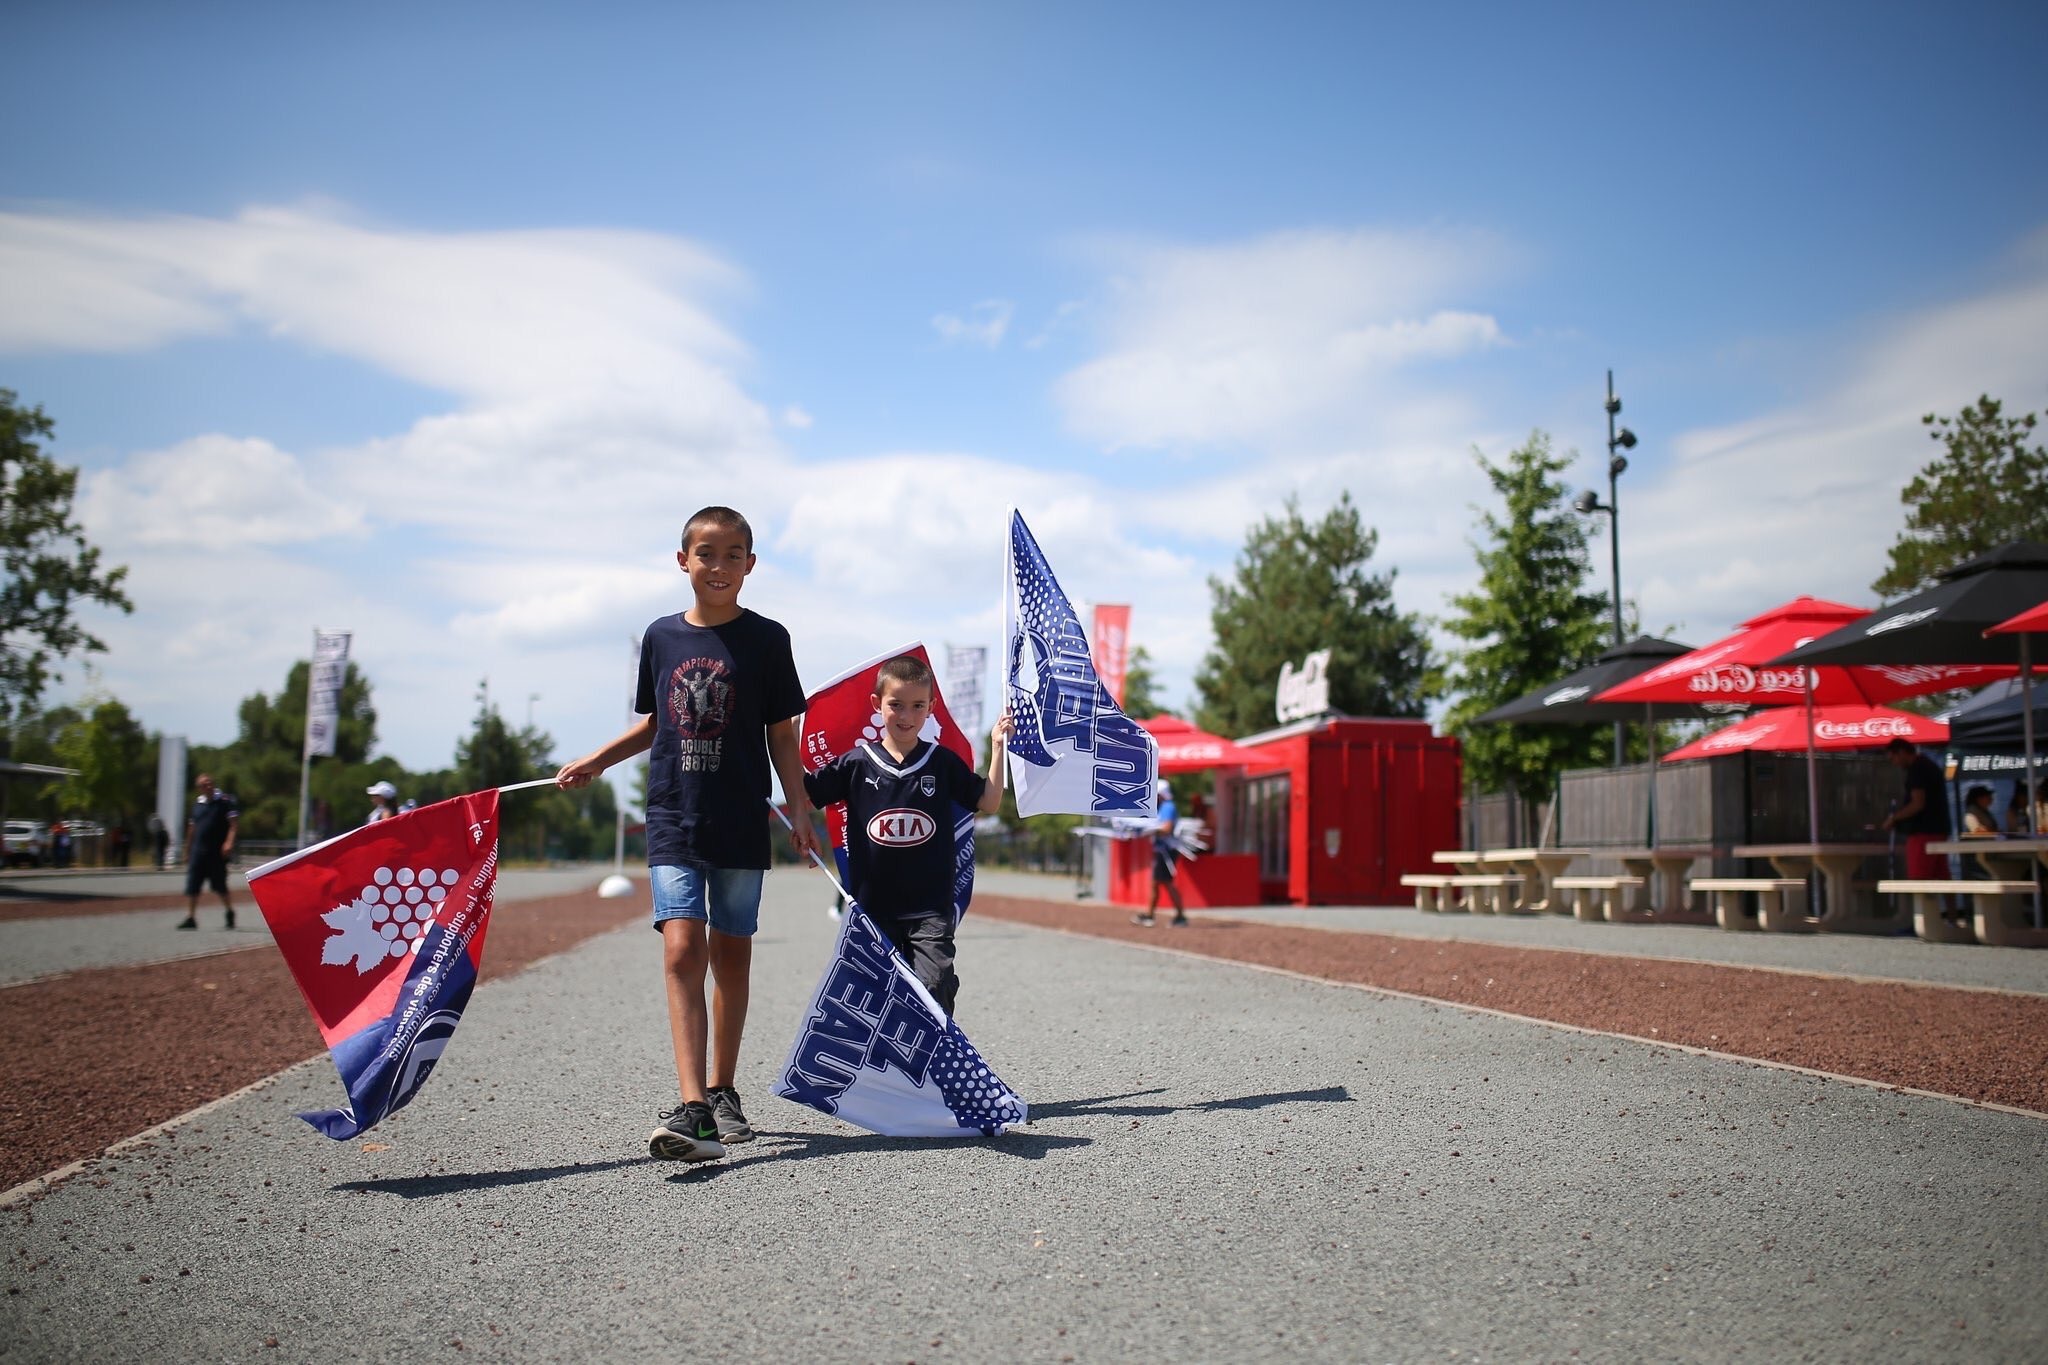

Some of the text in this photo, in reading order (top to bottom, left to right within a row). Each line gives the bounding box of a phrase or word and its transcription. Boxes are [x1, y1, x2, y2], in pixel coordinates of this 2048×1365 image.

[681, 737, 722, 755] DOUBLÉ
[807, 733, 817, 754] Les
[817, 730, 838, 764] Les vi
[879, 818, 925, 838] KIA
[466, 894, 478, 913] 1ers
[427, 911, 466, 974] supporters
[414, 975, 433, 997] des
